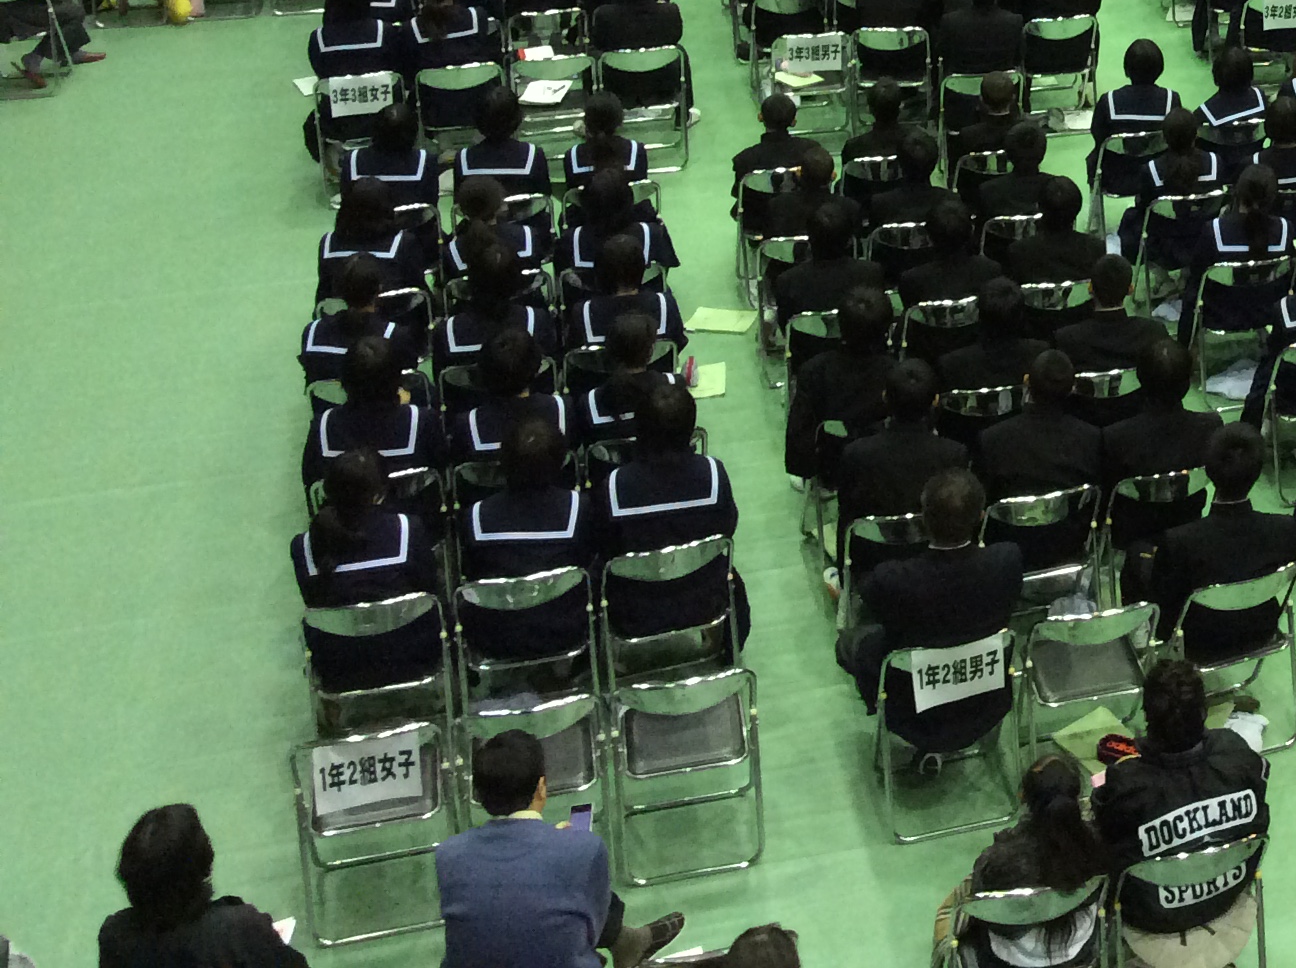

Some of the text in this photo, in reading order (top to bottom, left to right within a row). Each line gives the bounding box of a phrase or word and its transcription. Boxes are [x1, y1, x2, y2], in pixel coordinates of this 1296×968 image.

[788, 44, 841, 62] 3年3組男子
[332, 84, 391, 105] 3年3組女子
[917, 649, 1000, 690] 1年2組男子
[319, 749, 416, 792] 1年2組女子
[1143, 793, 1253, 852] DOCKLAND
